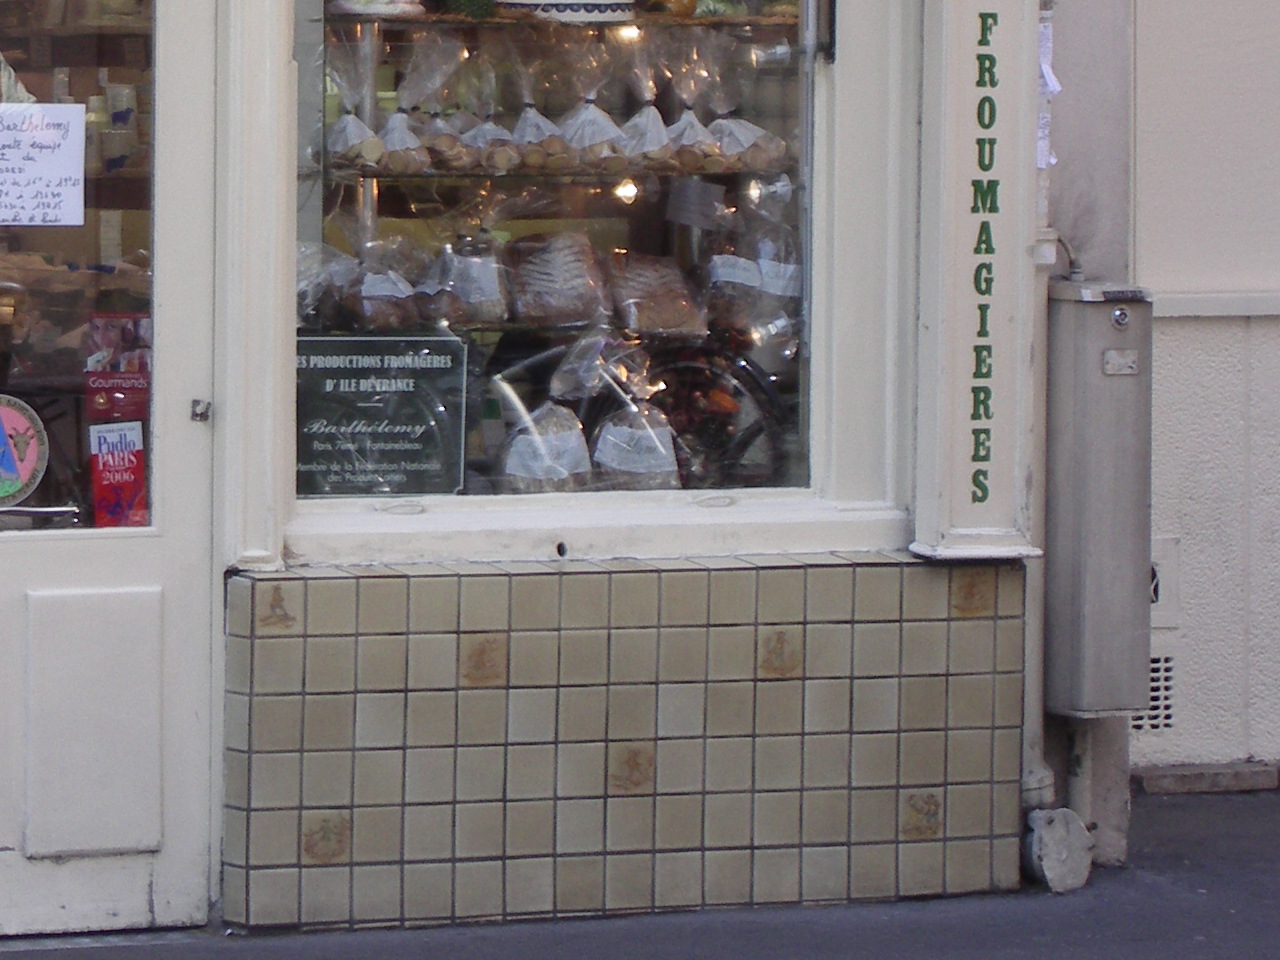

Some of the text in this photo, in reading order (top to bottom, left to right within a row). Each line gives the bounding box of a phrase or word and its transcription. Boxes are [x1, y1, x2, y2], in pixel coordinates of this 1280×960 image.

[970, 12, 1000, 503] FROUMAGIERES
[310, 355, 382, 369] PRODUCTIONS
[89, 376, 148, 388] Gourmands
[375, 379, 416, 392] FRANCE
[98, 450, 137, 470] PARIS
[102, 471, 135, 485] 2006
